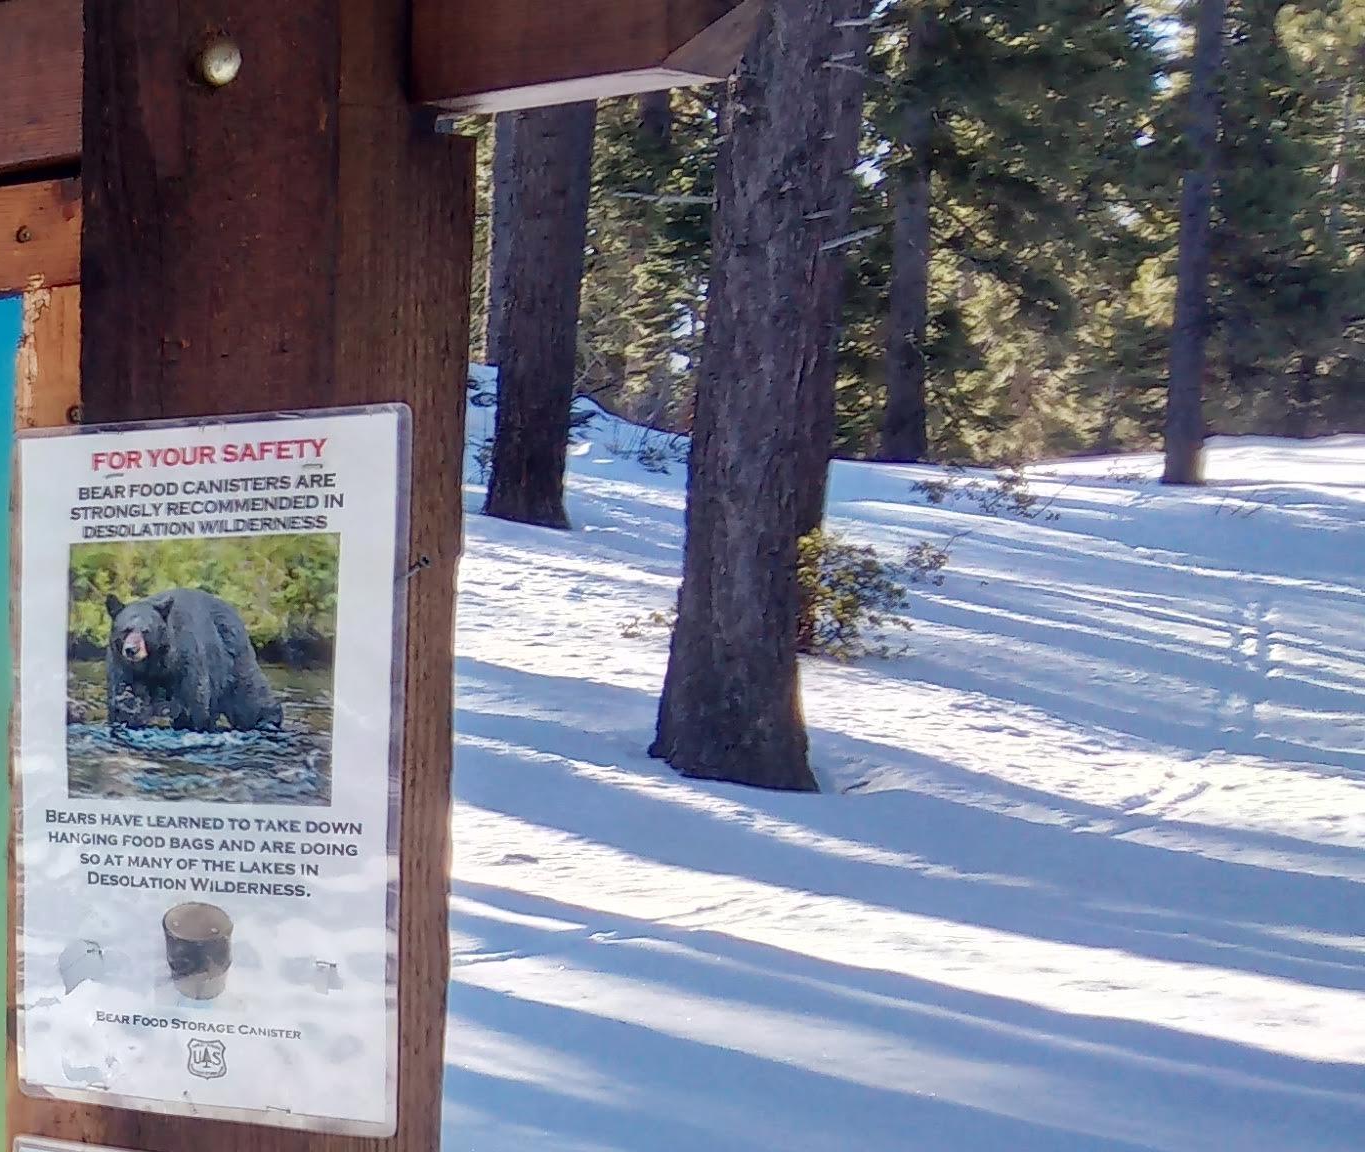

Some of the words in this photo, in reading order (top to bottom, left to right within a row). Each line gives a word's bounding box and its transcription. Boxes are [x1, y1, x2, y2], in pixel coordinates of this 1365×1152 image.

[92, 450, 142, 472] FOR
[146, 445, 216, 468] YOUR
[221, 437, 327, 463] SAFETY
[79, 484, 125, 501] BEAR
[129, 481, 179, 499] FOOD
[181, 475, 291, 496] CANISTERS
[295, 472, 336, 490] ARE
[70, 502, 163, 521] STRONGLY
[167, 494, 319, 517] RECOMMENDED
[324, 492, 344, 509] IN
[82, 521, 194, 540] DESOLATION
[199, 514, 327, 535] WILDERNESS
[46, 809, 97, 825] BEARS
[101, 813, 143, 827] HAVE
[147, 815, 224, 831] LEARNED
[227, 817, 250, 831] TO
[254, 818, 301, 833] TAKE
[305, 820, 362, 836] DOWN
[88, 870, 186, 891] DESOLATION
[190, 876, 311, 898] WILDERNESS.
[97, 1010, 130, 1025] BEAR
[133, 1014, 168, 1029] FOOD
[171, 1017, 235, 1034] STORAGE
[238, 1024, 301, 1040] CANISTER
